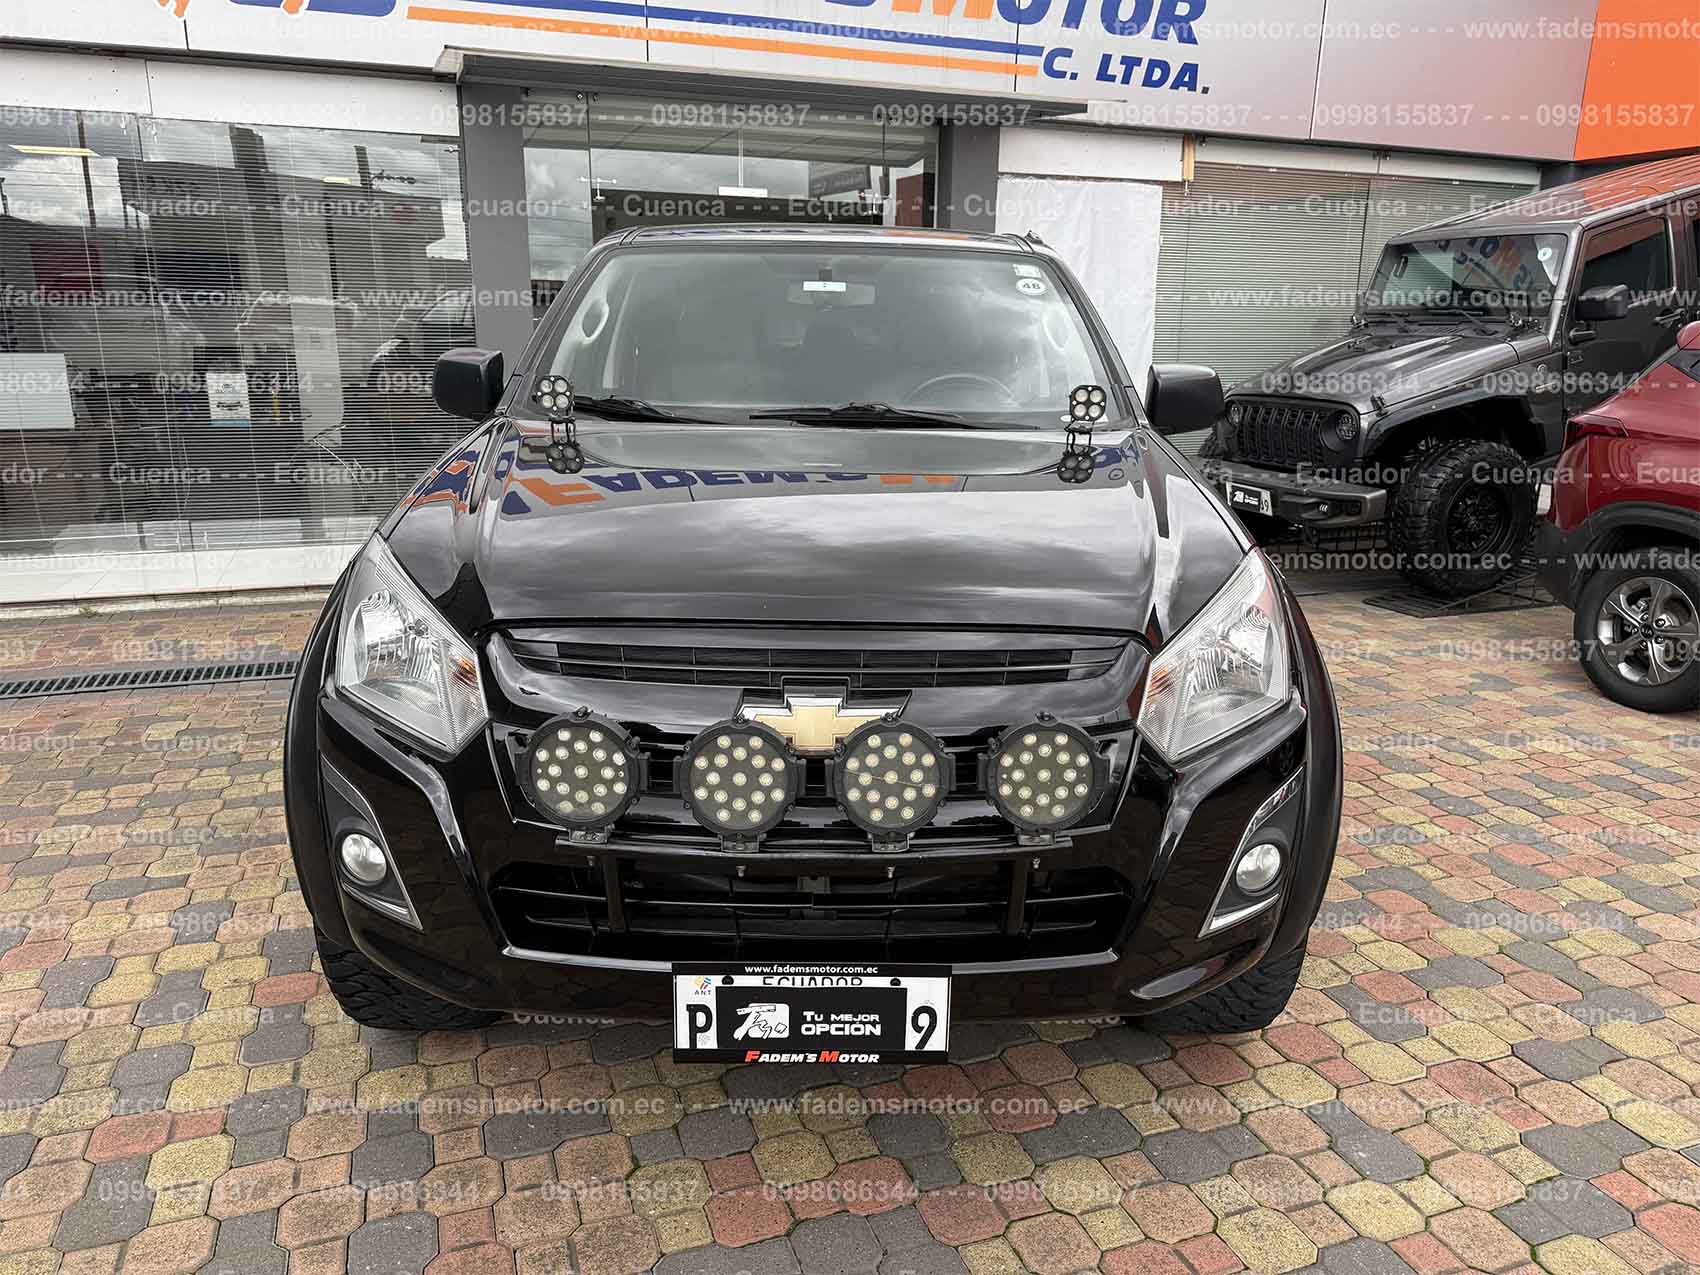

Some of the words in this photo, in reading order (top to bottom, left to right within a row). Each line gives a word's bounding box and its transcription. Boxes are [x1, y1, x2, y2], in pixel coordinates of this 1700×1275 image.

[1043, 47, 1078, 80] C.
[1095, 53, 1210, 94] LTDA.
[744, 963, 879, 975] www.fademsmotor.com.ec
[685, 1003, 713, 1049] P
[800, 1020, 882, 1036] OPCIÓN
[911, 1005, 938, 1050] 9
